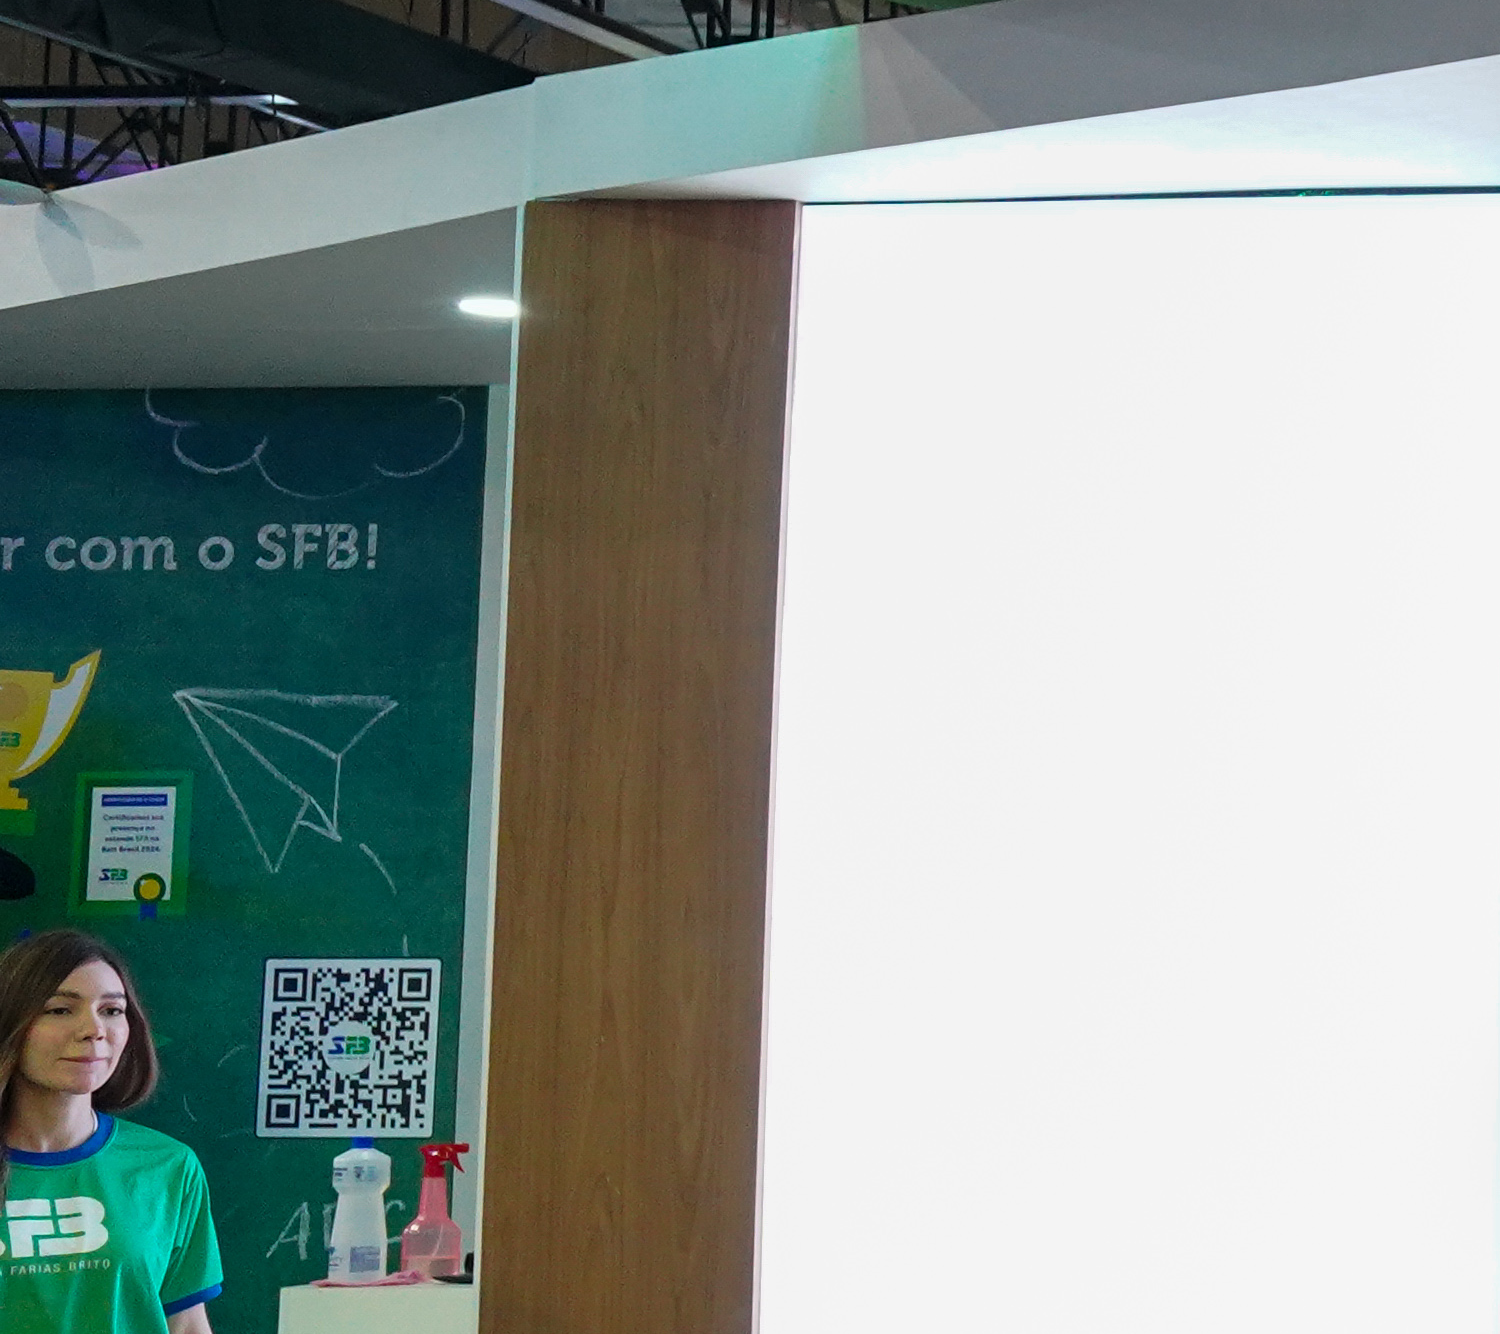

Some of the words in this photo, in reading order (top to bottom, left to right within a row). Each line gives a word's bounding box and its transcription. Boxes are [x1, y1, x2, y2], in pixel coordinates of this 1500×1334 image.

[45, 535, 178, 571] com
[198, 535, 235, 571] o
[255, 522, 379, 571] SFB!
[328, 1035, 371, 1055] SFB
[0, 1196, 109, 1258] FB
[10, 1263, 61, 1276] FARIAS
[69, 1258, 111, 1272] BRITO
